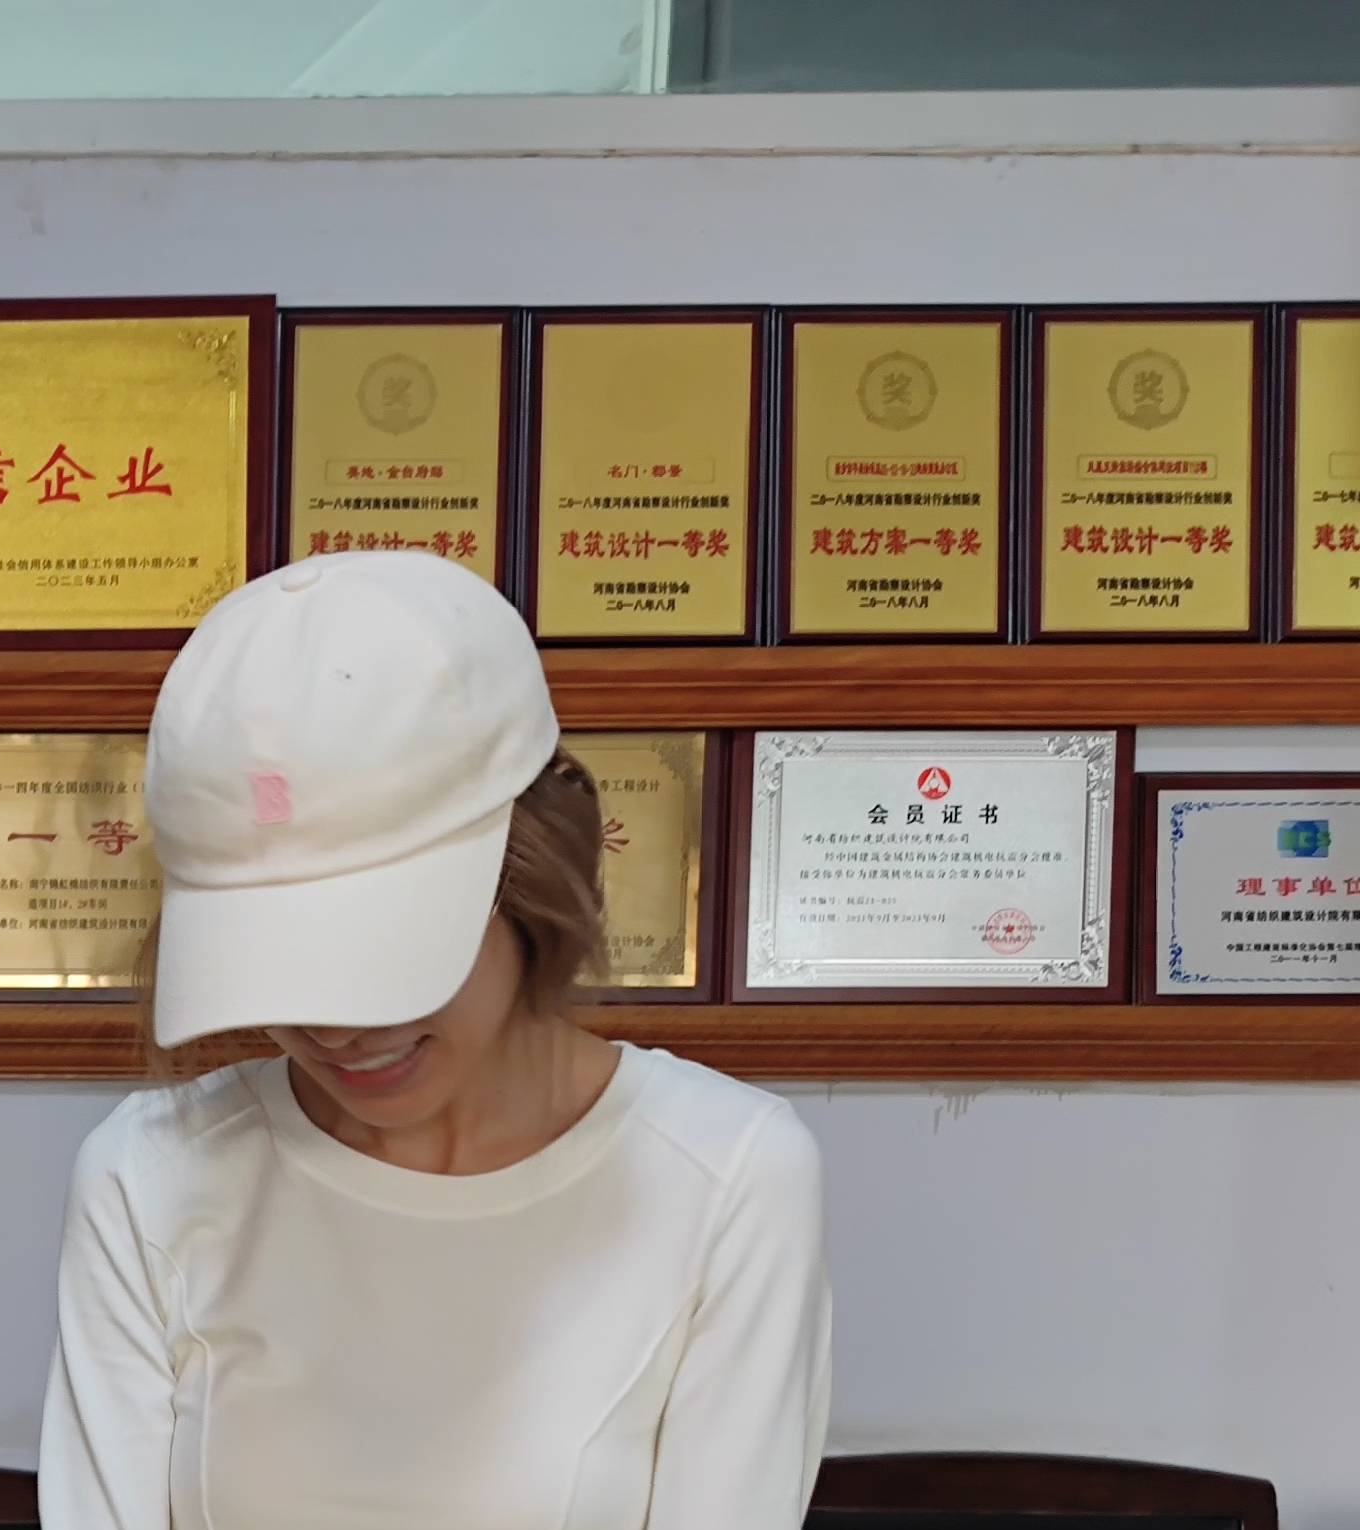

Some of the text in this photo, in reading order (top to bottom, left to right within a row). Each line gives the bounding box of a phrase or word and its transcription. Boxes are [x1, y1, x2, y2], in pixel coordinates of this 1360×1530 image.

[1133, 371, 1164, 405] 奖
[559, 530, 729, 559] 建筑设计一等奖
[810, 527, 982, 557] 建筑方案一等奖
[1061, 525, 1233, 555] 建筑设计一等奖
[868, 803, 999, 825] 会员证书
[7, 820, 139, 856] 一等
[604, 934, 654, 947] 设计协会
